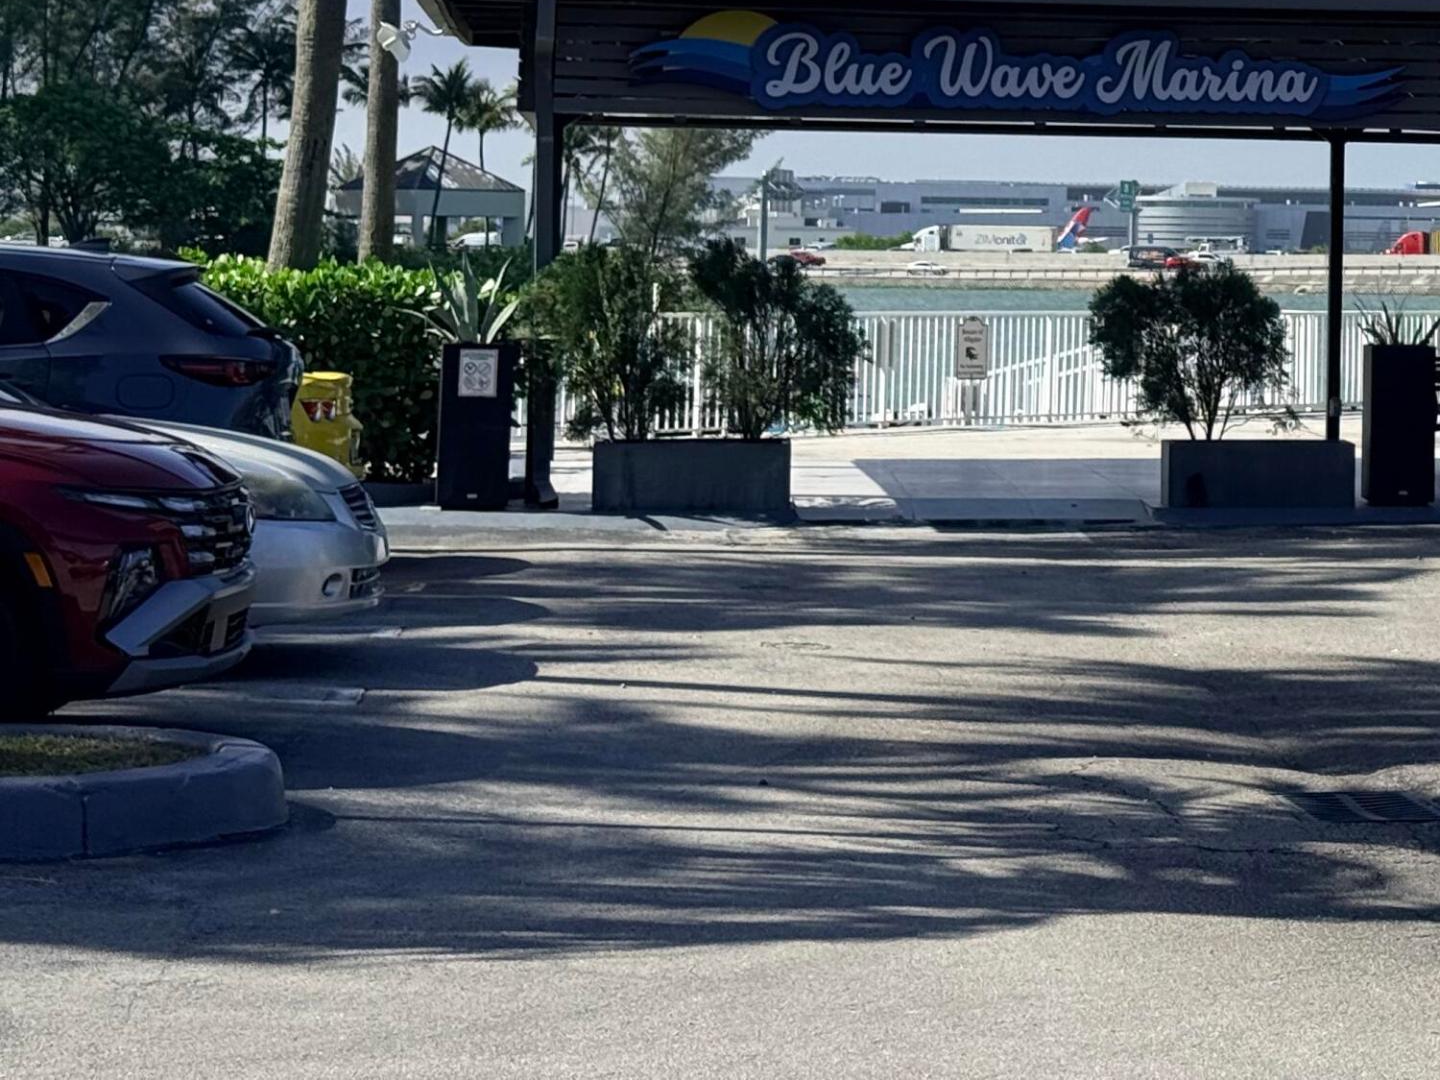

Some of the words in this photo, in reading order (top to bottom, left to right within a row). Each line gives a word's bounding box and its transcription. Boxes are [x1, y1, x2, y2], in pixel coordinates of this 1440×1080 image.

[765, 32, 912, 98] Blue
[924, 35, 1085, 99] Wave
[1096, 39, 1318, 104] Marina
